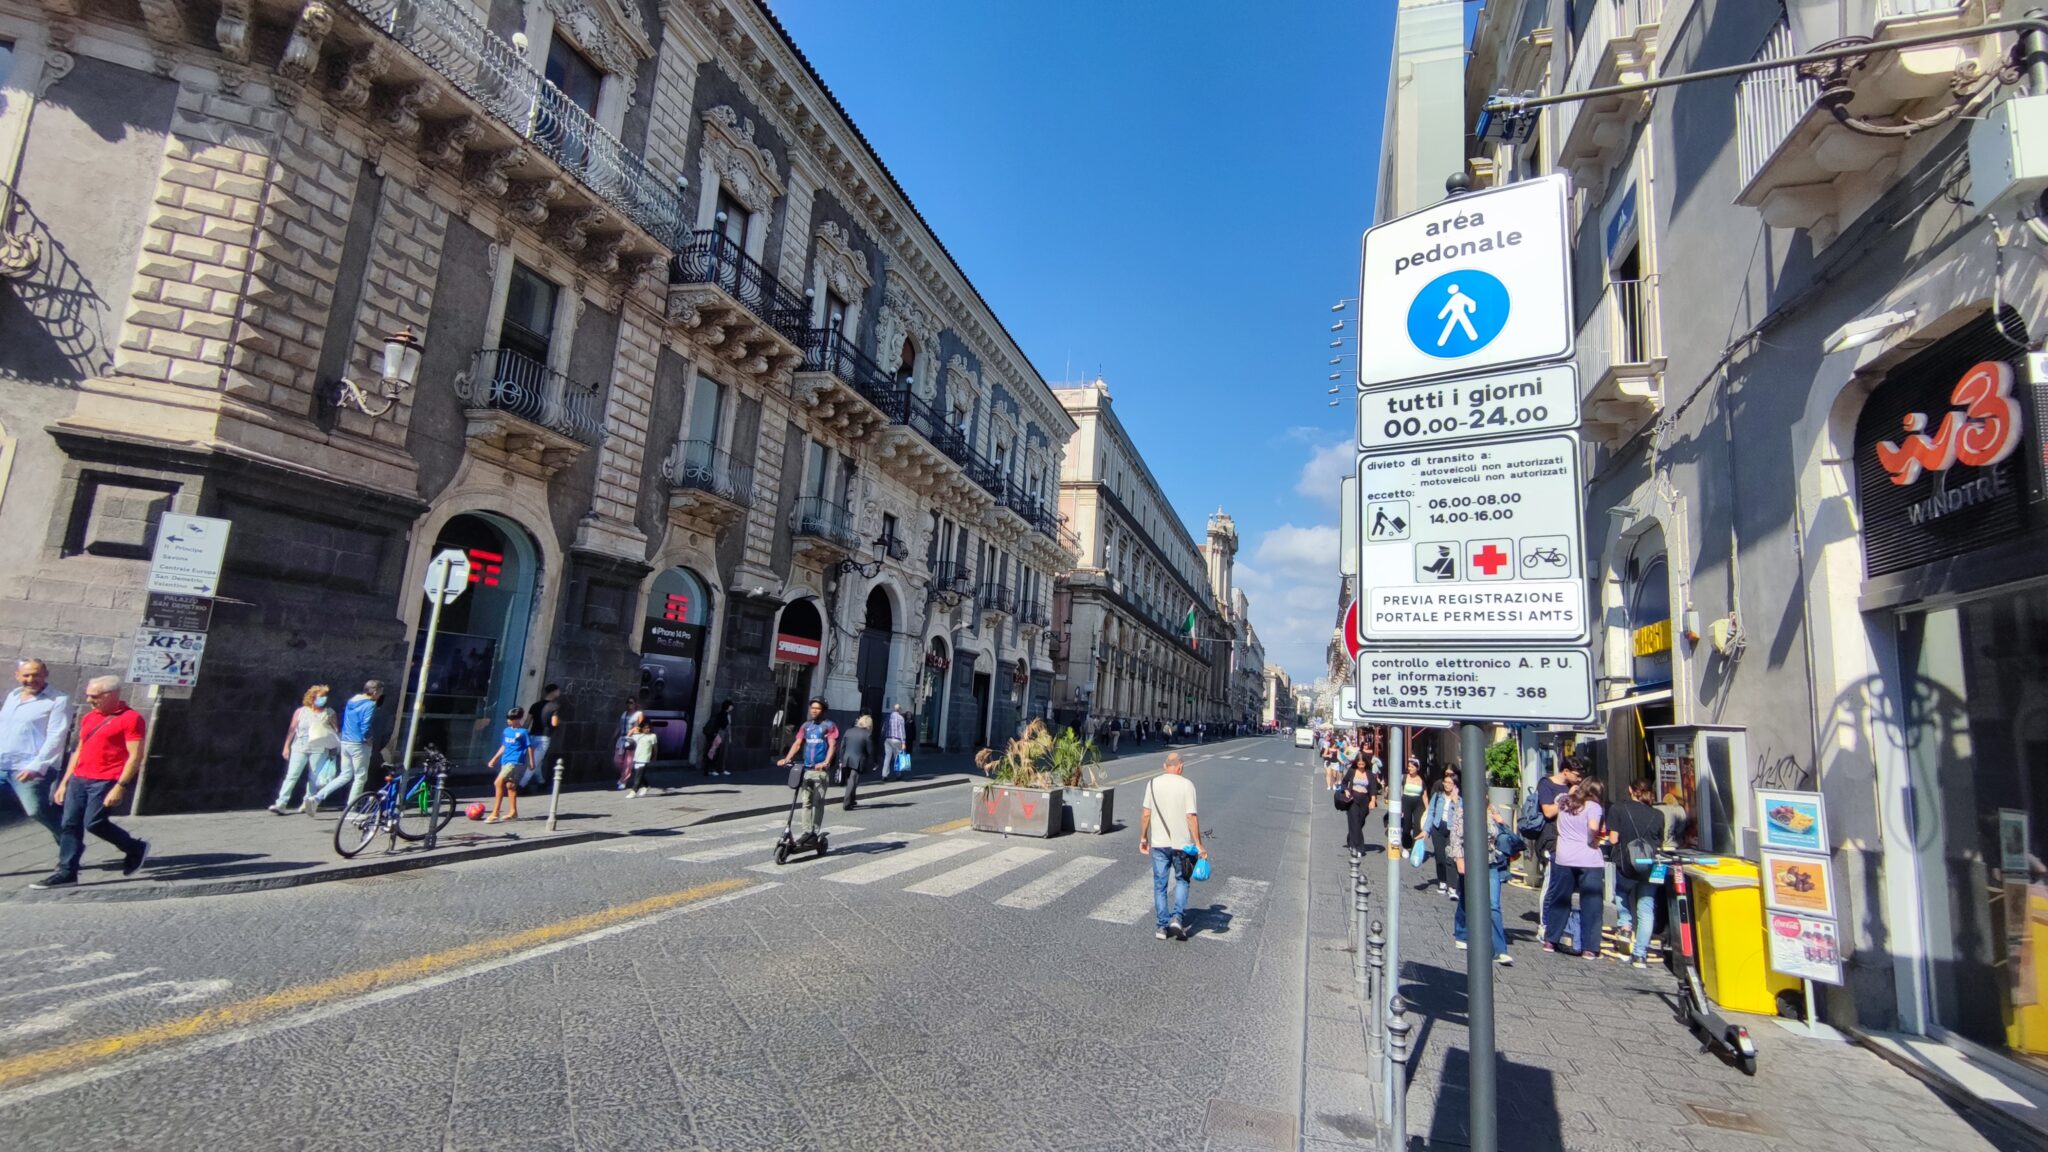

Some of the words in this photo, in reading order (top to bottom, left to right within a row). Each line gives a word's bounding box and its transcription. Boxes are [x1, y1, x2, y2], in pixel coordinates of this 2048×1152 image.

[1426, 212, 1485, 237] area
[1394, 230, 1523, 275] pedonale
[1387, 390, 1443, 414] tutti
[1453, 388, 1459, 406] i
[1468, 377, 1543, 408] giorni
[1384, 405, 1548, 438] 00.00-24.00
[1367, 460, 1406, 471] divieto
[1411, 457, 1421, 467] di
[1427, 453, 1475, 466] transito
[1480, 452, 1492, 461] a:
[1420, 464, 1477, 477] autoveicoli
[1482, 462, 1502, 471] non
[1506, 456, 1564, 469] autorizzati
[1420, 475, 1480, 487] motoveicoli
[1485, 472, 1505, 481] non
[1510, 467, 1568, 479] autorizzati
[1367, 489, 1415, 501] eccetto:
[1428, 492, 1522, 509] 06.00-08.00
[1908, 468, 2009, 525] WINDTRE
[1430, 508, 1514, 524] 14.00-16.00
[1383, 595, 1434, 606] PREVIA
[1438, 592, 1564, 605] REGISTRAZIONE
[1376, 612, 1439, 622] PORTALE
[1444, 611, 1523, 622] PERMESSI
[1528, 610, 1574, 621] AMTS
[1372, 657, 1429, 668] controllo
[1436, 657, 1511, 668] elettronico
[1518, 657, 1533, 668] A.
[1541, 657, 1550, 669] P.
[1557, 657, 1573, 669] U.
[1372, 673, 1391, 682] per
[1398, 671, 1479, 682] informazioni:
[1373, 686, 1393, 696] tel.
[1400, 685, 1428, 696] 095
[1435, 686, 1496, 697] 7519367
[1516, 686, 1547, 698] 368
[1372, 697, 1462, 710] ztl@amts.ct.it
